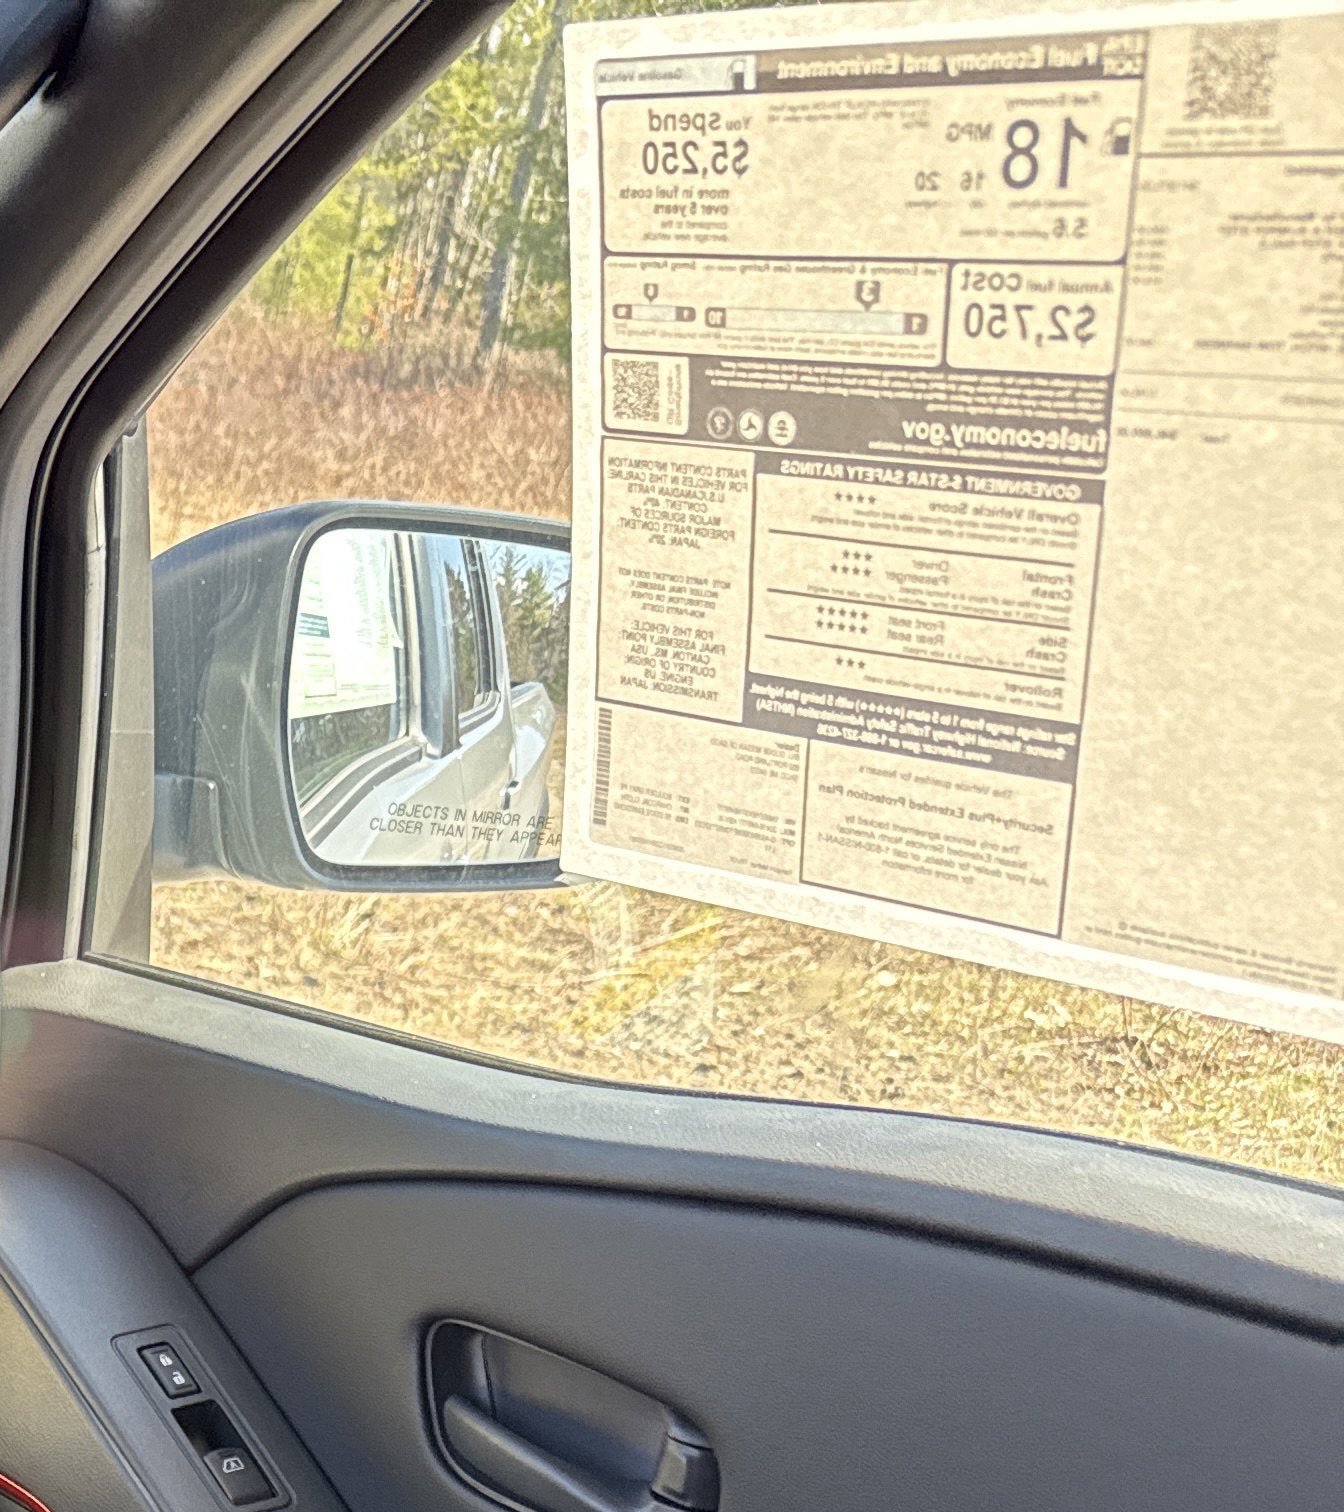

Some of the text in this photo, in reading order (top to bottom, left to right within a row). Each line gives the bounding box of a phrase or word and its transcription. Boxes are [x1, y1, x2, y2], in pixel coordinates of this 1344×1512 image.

[387, 801, 554, 831] OBJECTS IN MIRROR ARE
[369, 818, 424, 836] CLOSER
[430, 822, 465, 839] THAN
[470, 826, 505, 844] THEY
